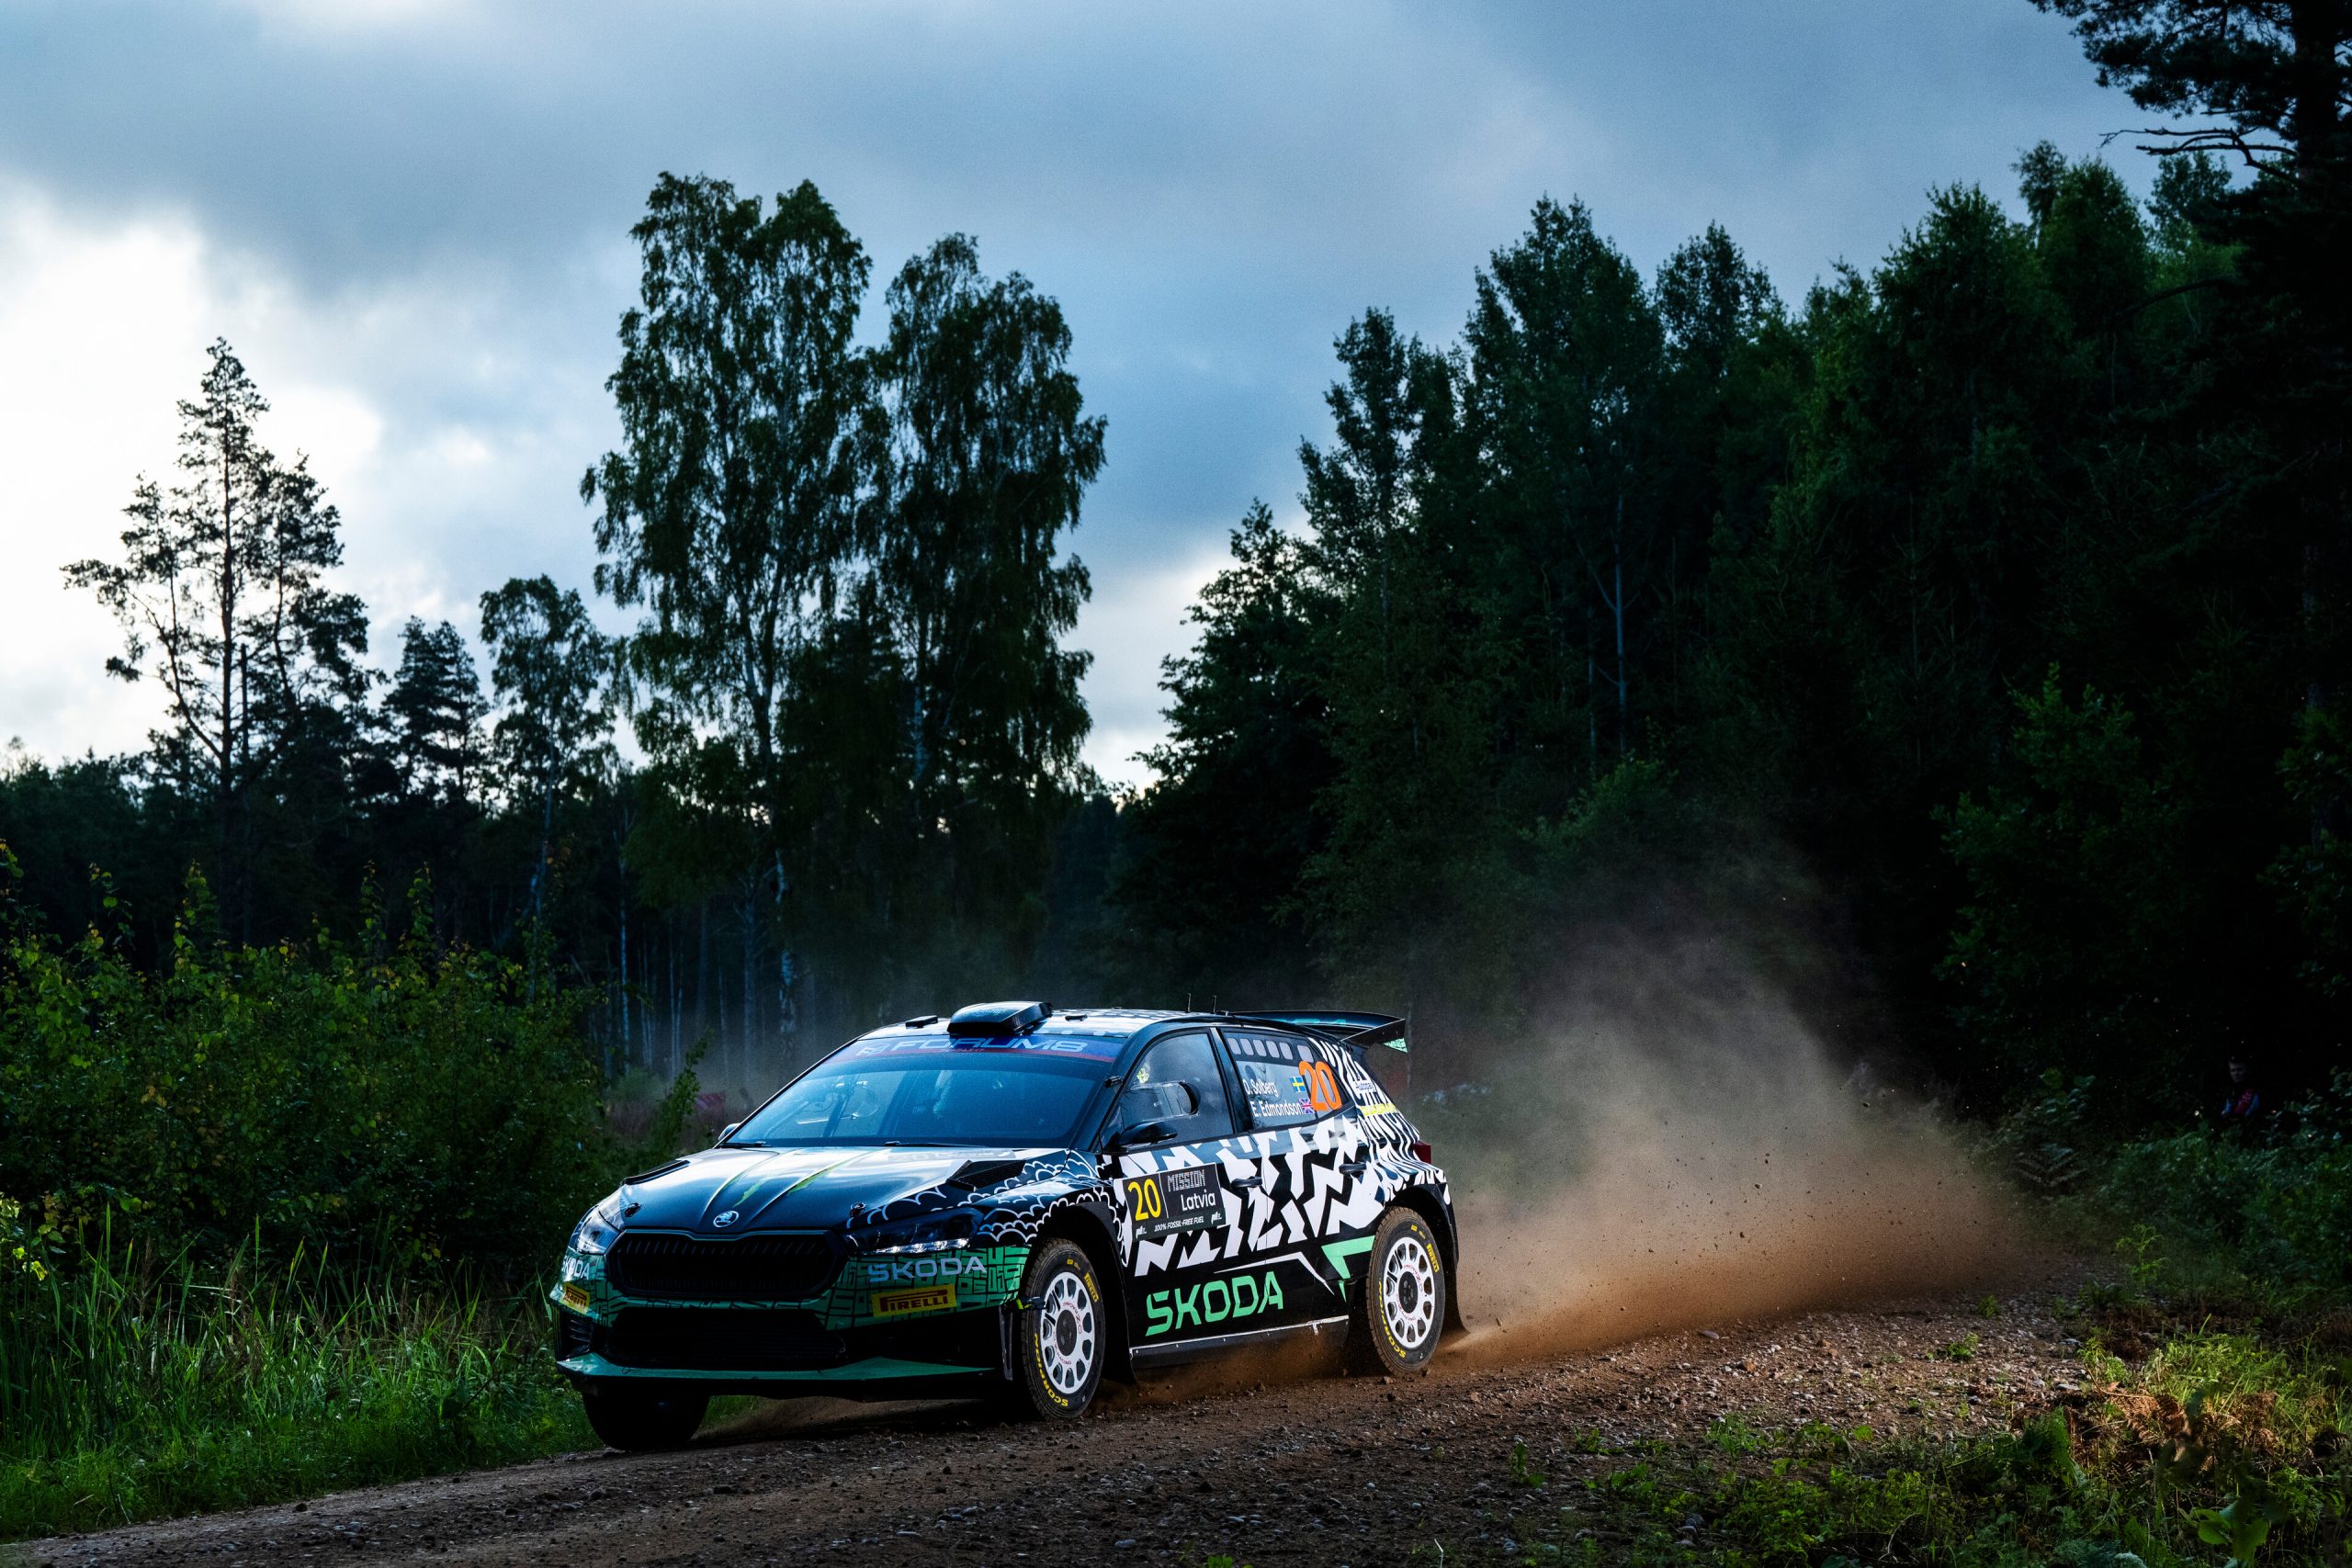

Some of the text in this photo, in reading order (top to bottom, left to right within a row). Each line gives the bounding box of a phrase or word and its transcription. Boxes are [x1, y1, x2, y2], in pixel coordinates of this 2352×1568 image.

[1251, 1079, 1279, 1098] Solberg
[1298, 1060, 1342, 1111] 20
[1250, 1099, 1303, 1118] E. Edmondson
[1167, 1169, 1206, 1192] MISSION
[1127, 1179, 1161, 1221] 20
[1180, 1189, 1216, 1212] Latvia
[879, 1289, 948, 1313] PIRELLI
